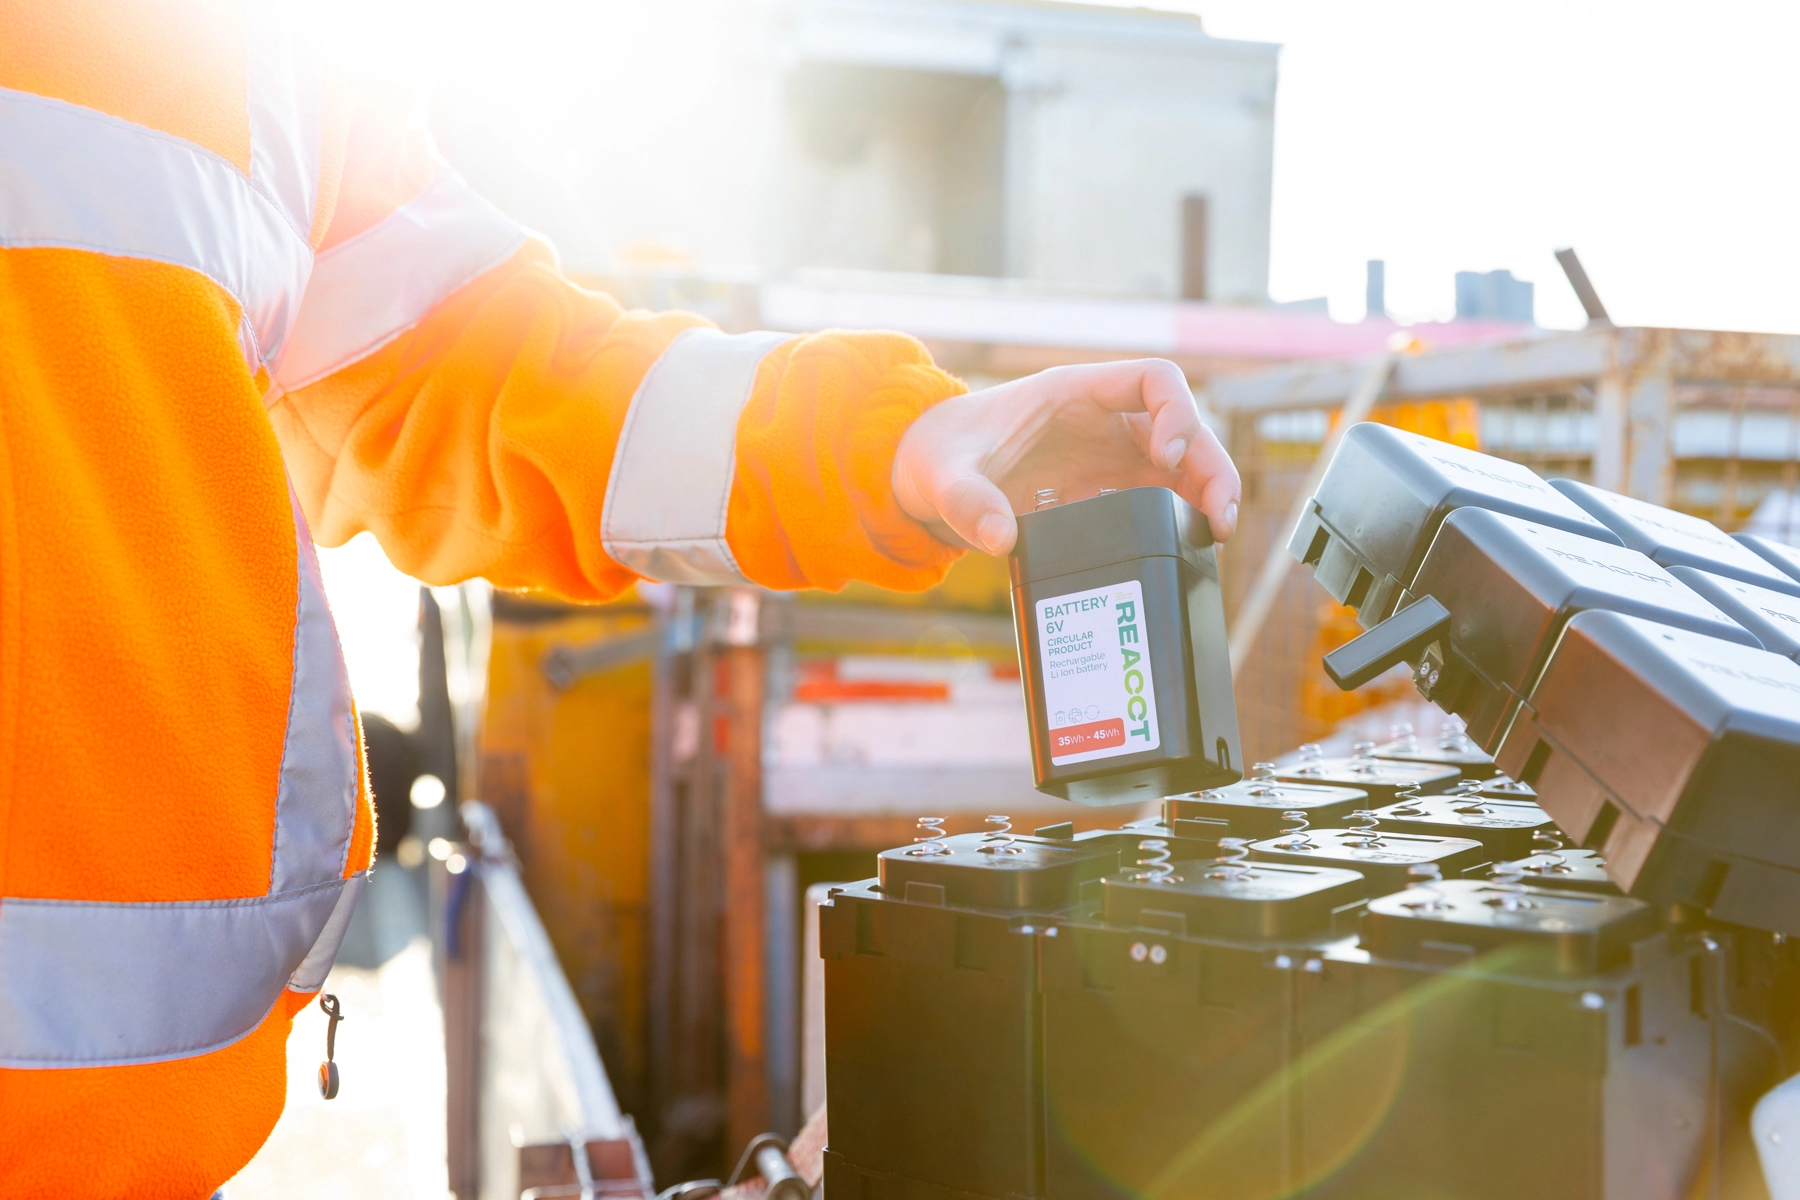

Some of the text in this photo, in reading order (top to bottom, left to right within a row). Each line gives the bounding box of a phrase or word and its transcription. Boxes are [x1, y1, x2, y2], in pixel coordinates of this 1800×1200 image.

[1044, 595, 1109, 619] BATTERY
[1046, 620, 1064, 634] 6V
[1047, 631, 1094, 647] CIRCULAR
[1048, 641, 1093, 656] PRODUCT
[1049, 652, 1106, 669] Rechargable
[1050, 669, 1059, 679] Li
[1076, 661, 1108, 674] battery
[1115, 600, 1151, 742] REACCT
[1058, 734, 1085, 747] 35Wh
[1093, 728, 1120, 740] 45Wh
